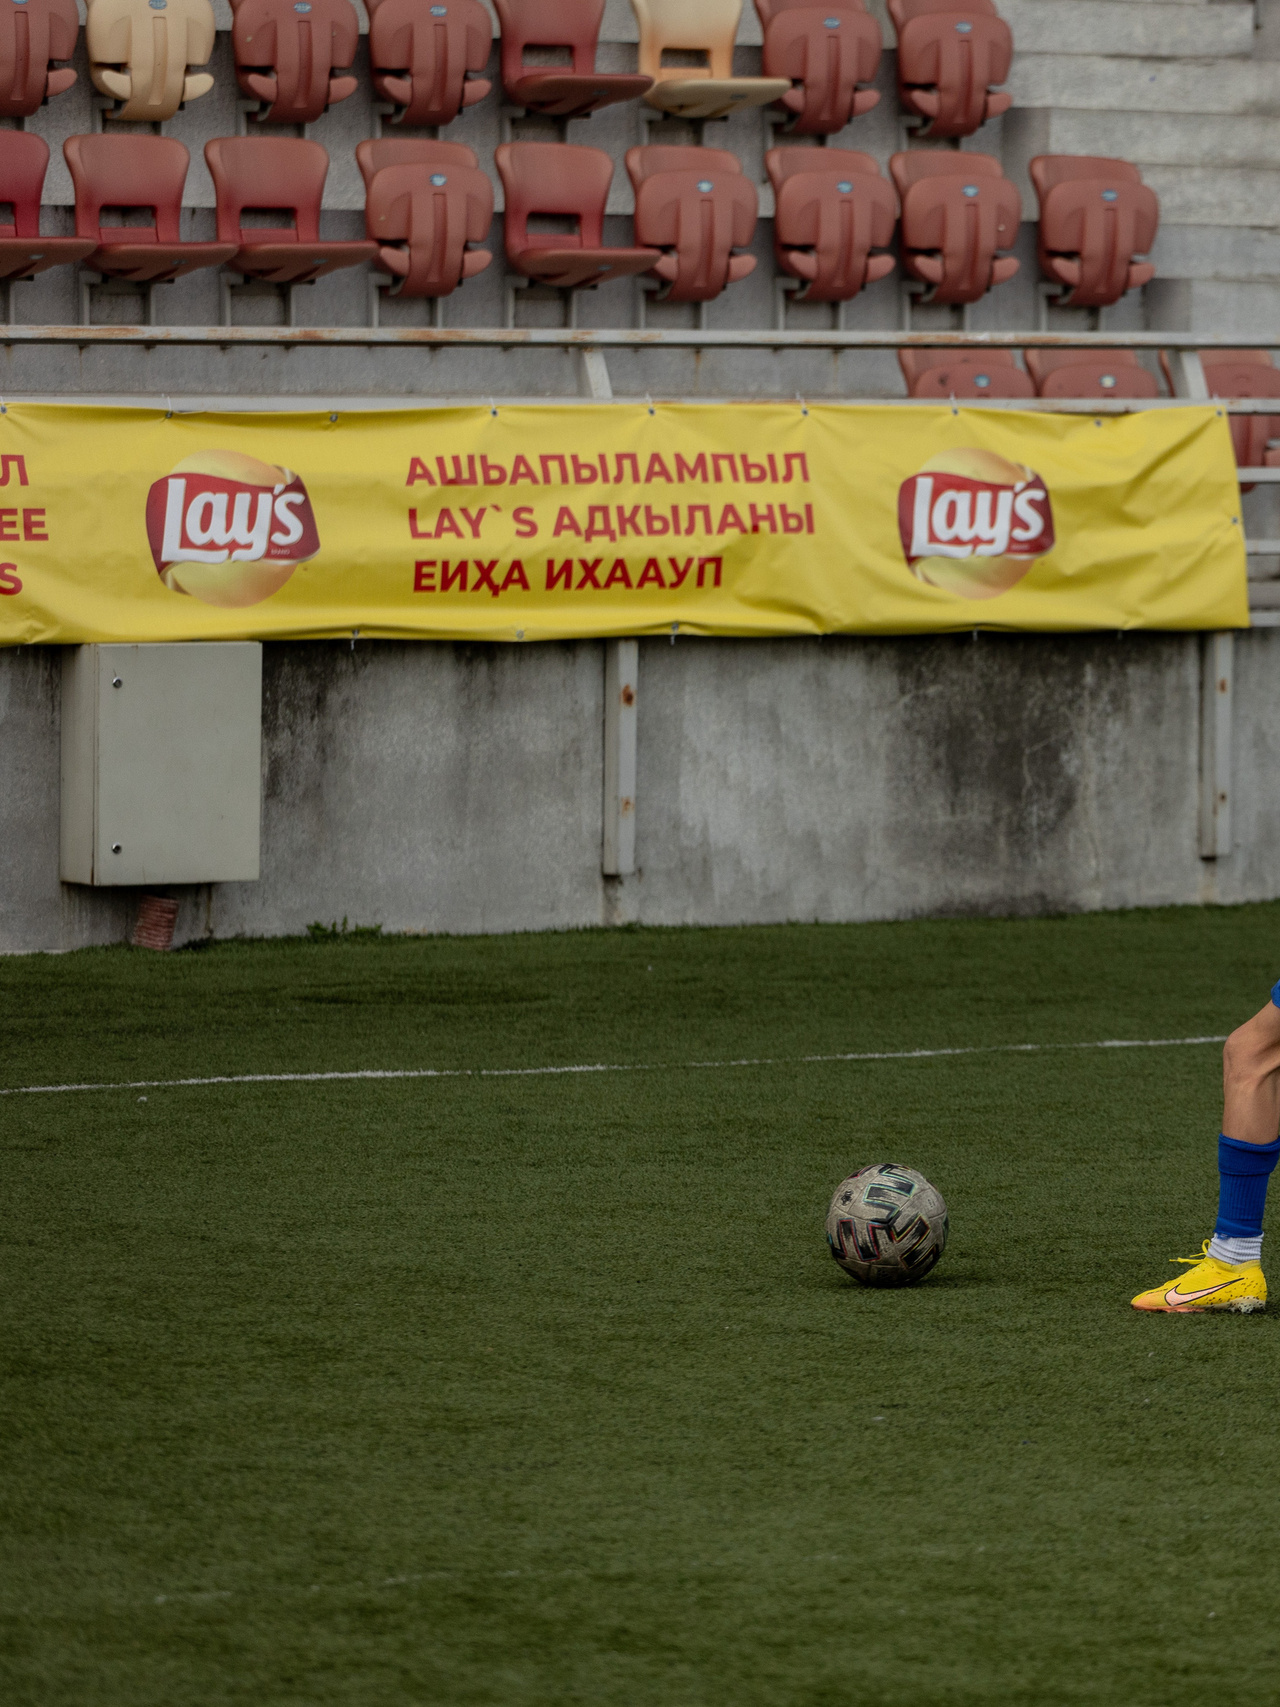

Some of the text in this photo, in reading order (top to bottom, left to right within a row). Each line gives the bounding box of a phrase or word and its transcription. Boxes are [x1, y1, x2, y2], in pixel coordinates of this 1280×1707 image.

[405, 452, 810, 487] АШЬАПЫЛАМПЫЛ
[161, 477, 306, 564] Lay's
[552, 503, 816, 543] АДКЫЛАНЫ
[910, 477, 1047, 559] Lay's
[544, 556, 724, 592] ИХААУП
